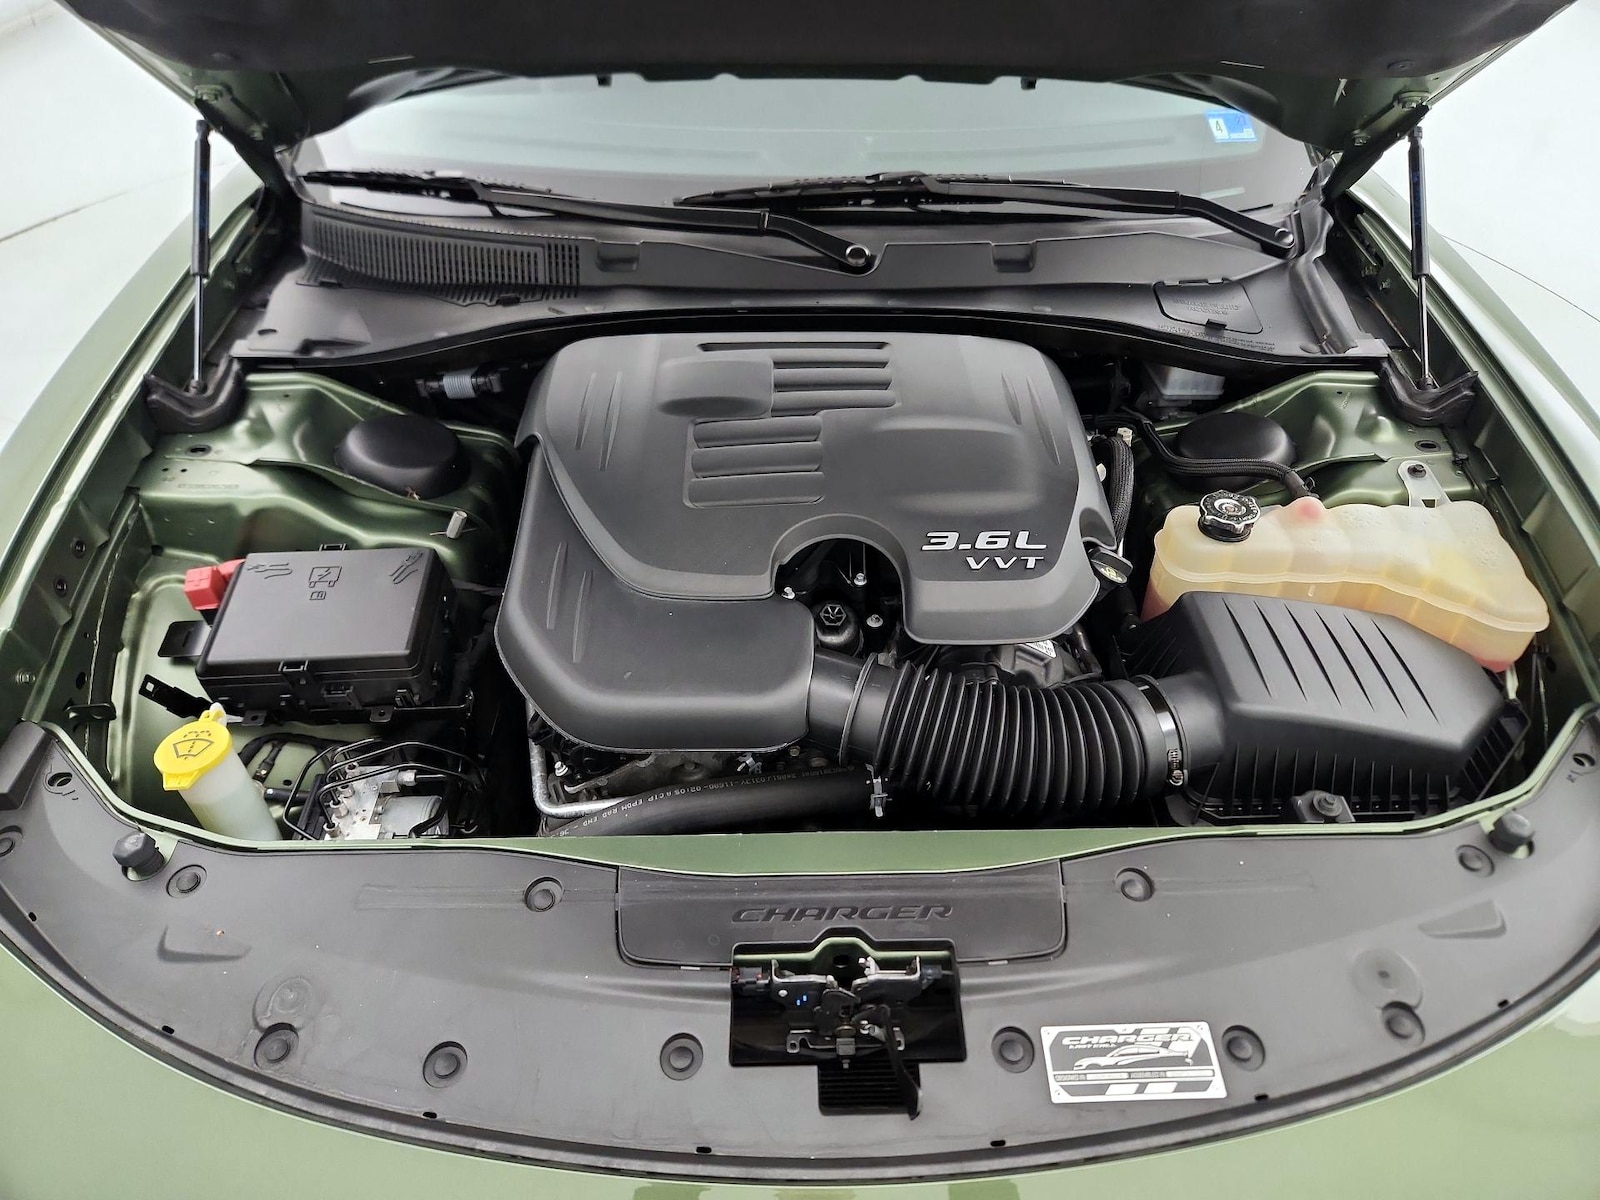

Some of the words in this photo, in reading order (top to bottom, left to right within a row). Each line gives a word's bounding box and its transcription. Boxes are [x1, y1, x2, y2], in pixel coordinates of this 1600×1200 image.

[921, 530, 1047, 550] 3.6L
[965, 556, 1044, 569] VVT
[621, 799, 643, 811] EPDM
[602, 808, 618, 819] RAD
[582, 816, 598, 827] END
[731, 905, 953, 923] CHARGER
[1061, 1033, 1195, 1045] CHARGER
